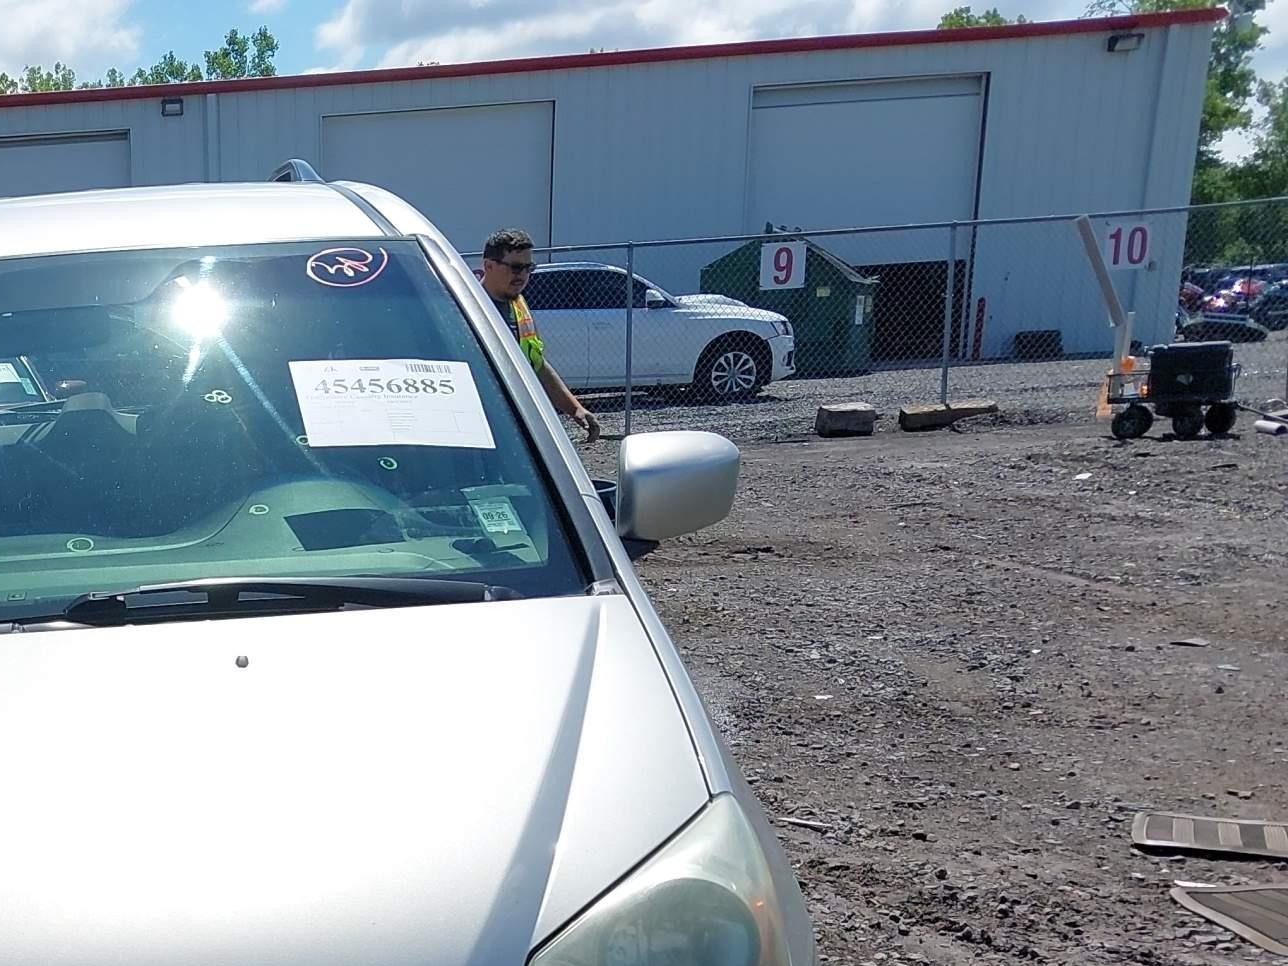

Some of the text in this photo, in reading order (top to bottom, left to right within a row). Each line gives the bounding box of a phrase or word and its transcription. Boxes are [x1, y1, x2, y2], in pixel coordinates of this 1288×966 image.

[1108, 226, 1149, 265] 10
[773, 247, 794, 285] 9
[314, 377, 455, 395] 45456885
